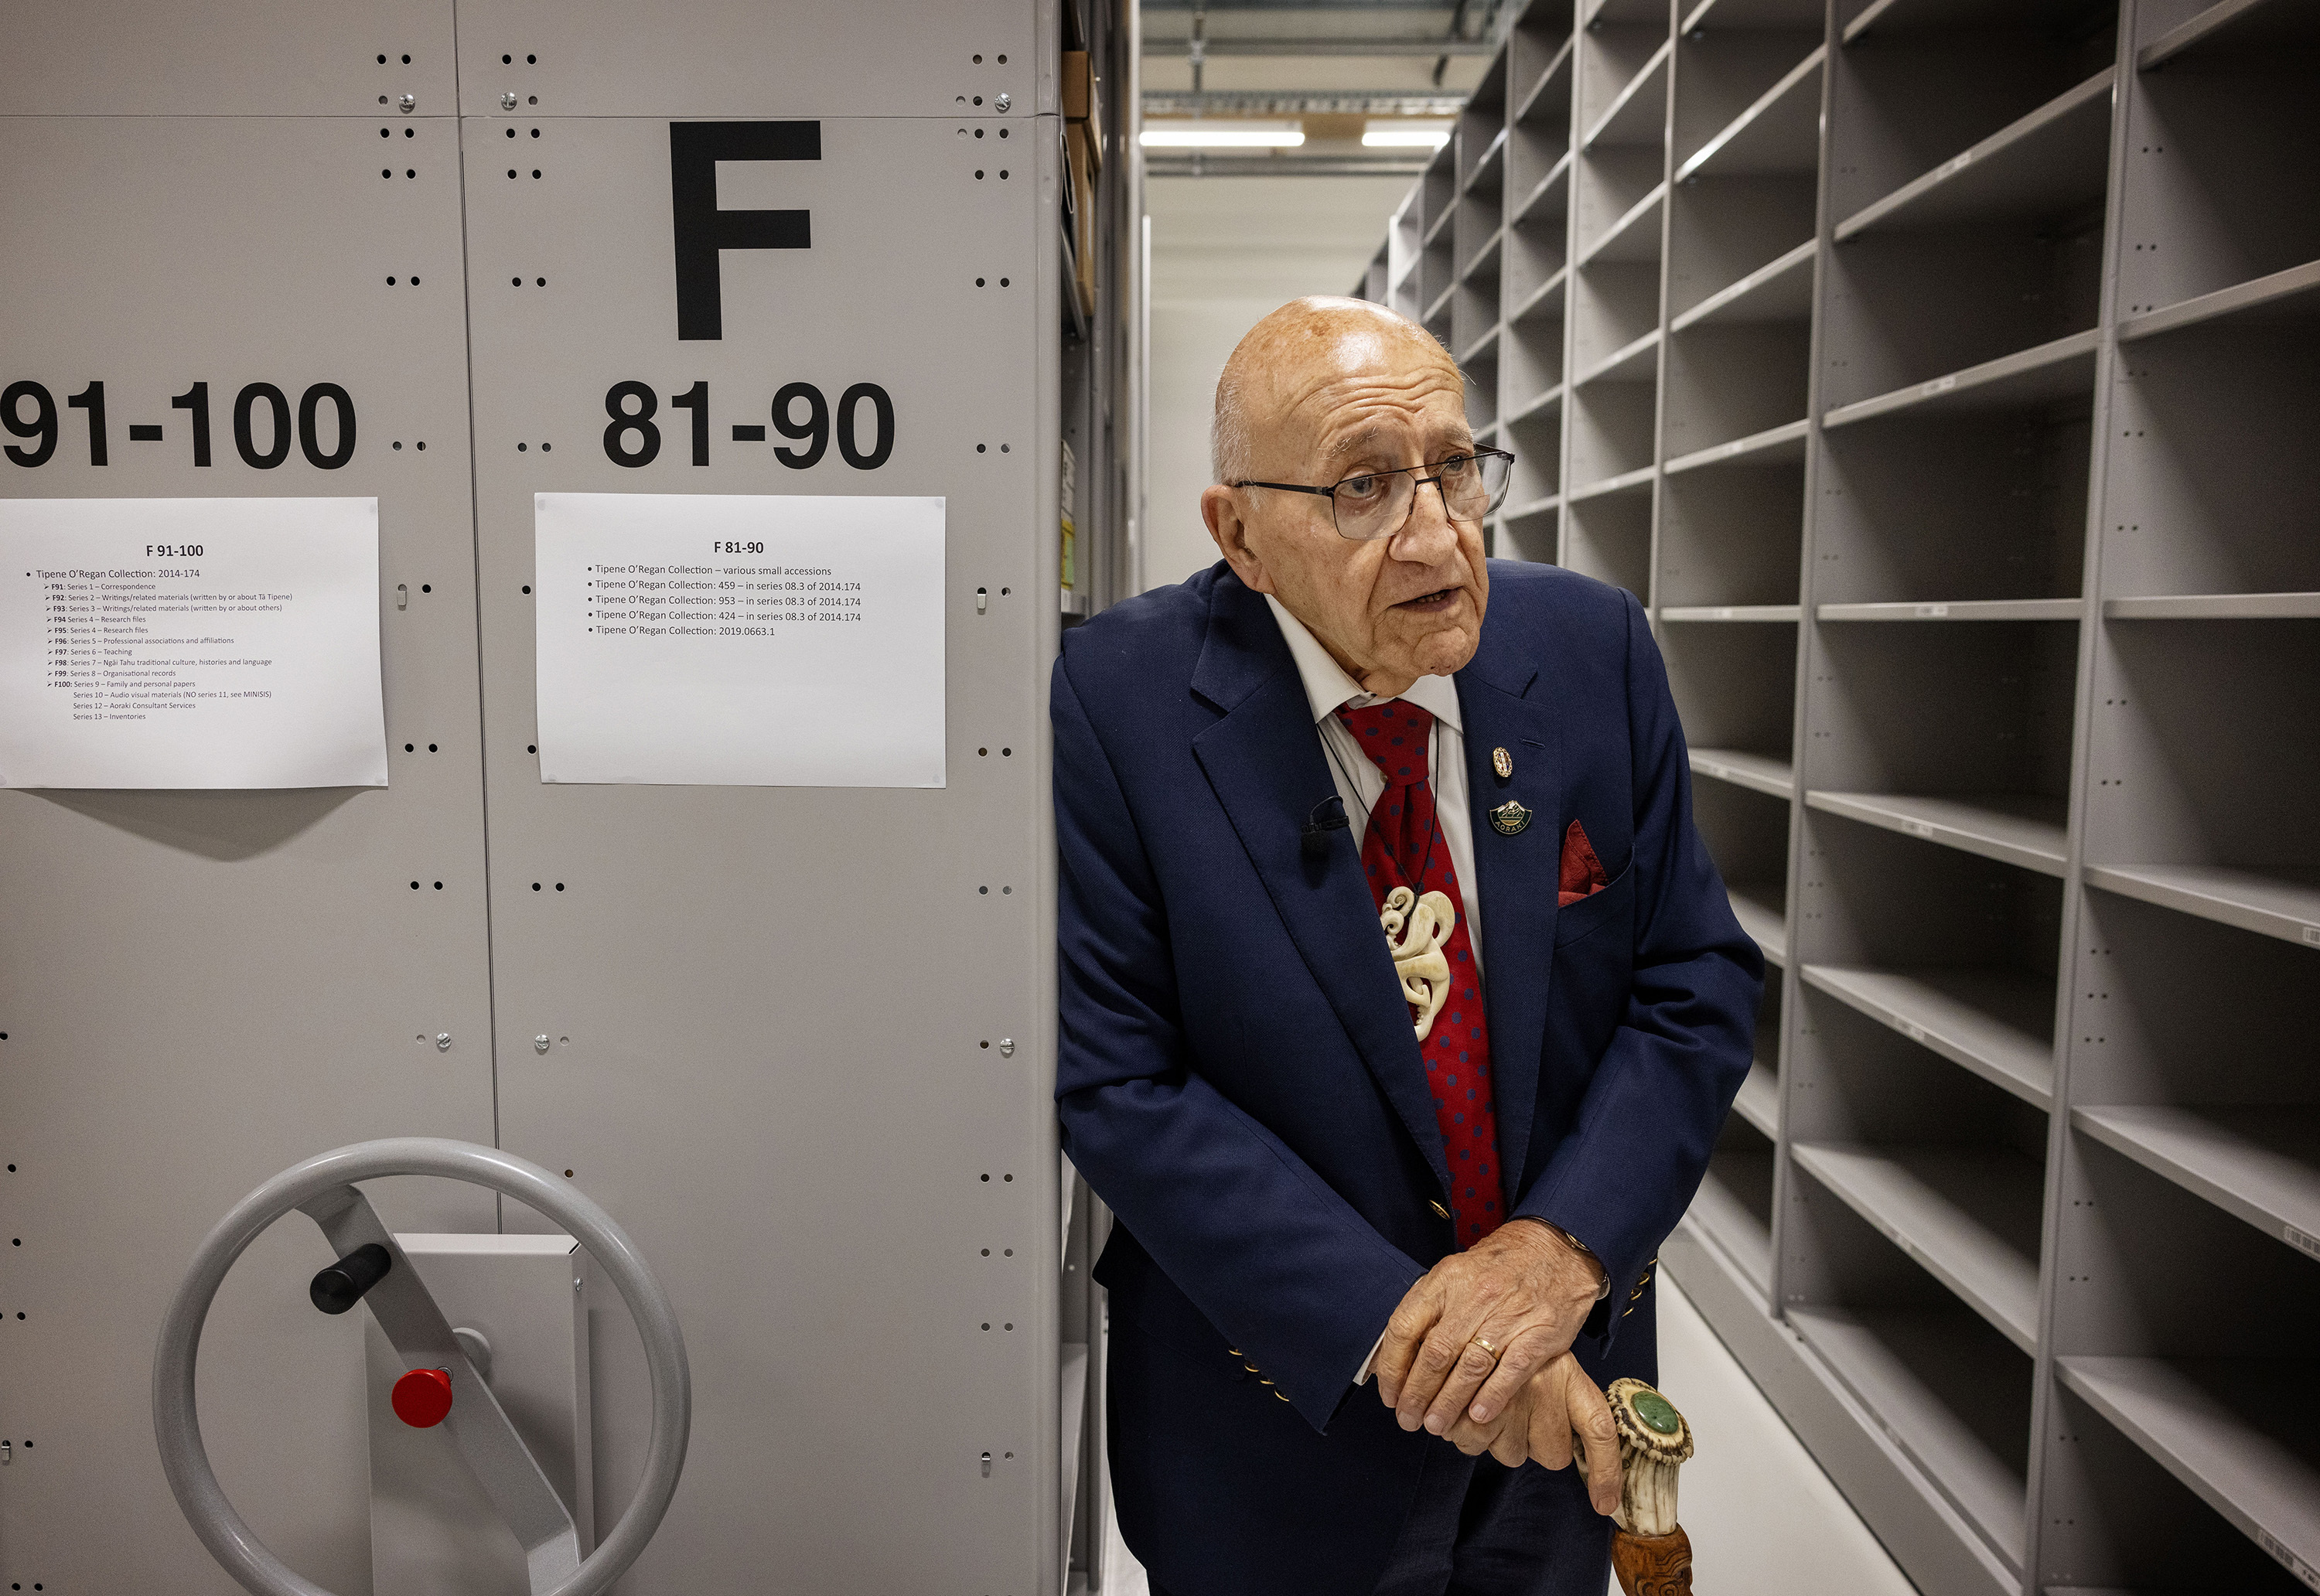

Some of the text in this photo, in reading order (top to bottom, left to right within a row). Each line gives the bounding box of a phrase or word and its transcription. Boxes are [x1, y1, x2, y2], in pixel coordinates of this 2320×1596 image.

[670, 121, 821, 340] F
[0, 380, 356, 469] 91-100
[604, 381, 894, 469] 81-90
[146, 544, 203, 557] F 91-100
[714, 541, 763, 554] F 81-90
[36, 569, 200, 580] Tipene O’Regan Collection: 2014-174
[595, 564, 626, 575] Tipene
[628, 564, 665, 575] O’Regan
[668, 564, 712, 574] Collection
[722, 566, 756, 575] various
[758, 566, 781, 575] small
[784, 567, 831, 575] accessions
[595, 579, 626, 590] Tipene
[628, 579, 665, 591] O’Regan
[668, 580, 715, 589] Collection:
[718, 581, 735, 589] 459
[745, 581, 754, 589] in
[756, 581, 783, 590] series
[784, 581, 804, 590] 08.3
[807, 581, 817, 591] of
[819, 581, 861, 591] 2014.174
[101, 593, 156, 602] Writings/related
[218, 593, 227, 602] by
[595, 595, 626, 605] Tipene
[628, 595, 666, 605] O’Regan
[668, 595, 715, 605] Collection:
[718, 596, 735, 605] 953
[745, 596, 754, 605] in
[756, 596, 783, 605] series
[785, 597, 804, 605] 08.3
[807, 596, 817, 605] of
[819, 597, 861, 606] 2014.174
[102, 604, 156, 613] Writings/related
[190, 604, 217, 612] (written
[595, 610, 626, 620] Tipene
[629, 610, 666, 621] O’Regan
[668, 610, 716, 619] Collection:
[718, 611, 735, 619] 424
[746, 612, 754, 620] in
[756, 612, 783, 620] series
[785, 612, 804, 621] 08.3
[807, 612, 817, 621] of
[819, 612, 861, 621] 2014.174
[595, 625, 775, 636] Tipene O’Regan Collection: 2019.0663.1
[242, 658, 272, 667] language
[103, 670, 150, 678] Organisational
[1495, 820, 1525, 832] AORAKI
